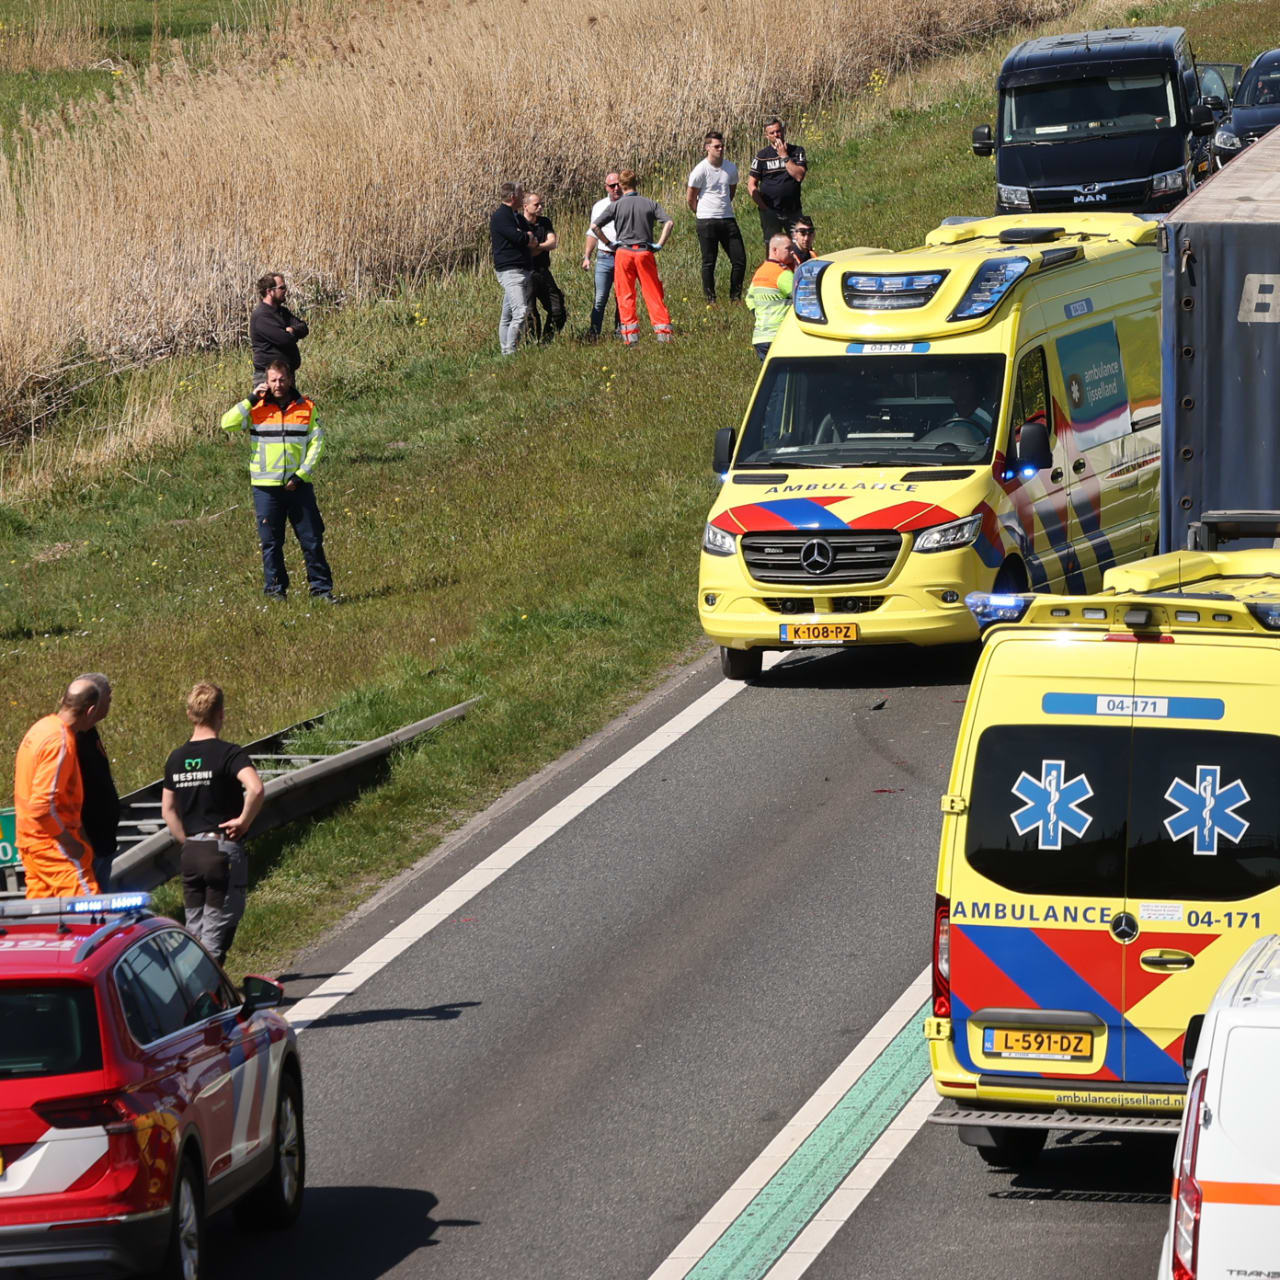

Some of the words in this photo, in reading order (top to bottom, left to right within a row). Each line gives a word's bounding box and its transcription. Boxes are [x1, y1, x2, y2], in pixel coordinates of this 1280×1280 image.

[1074, 194, 1107, 203] MAN
[1084, 361, 1119, 383] ambulance
[1086, 378, 1118, 407] ijsselland
[764, 482, 918, 495] AMBULANCE
[793, 626, 851, 639] K-108-PZ
[1107, 699, 1157, 713] 04-171
[952, 901, 1112, 924] AMBULANCE
[1187, 909, 1261, 929] 04-171
[1004, 1032, 1084, 1053] L-591-DZ
[1056, 1092, 1185, 1107] ambulanceijsselland.nl
